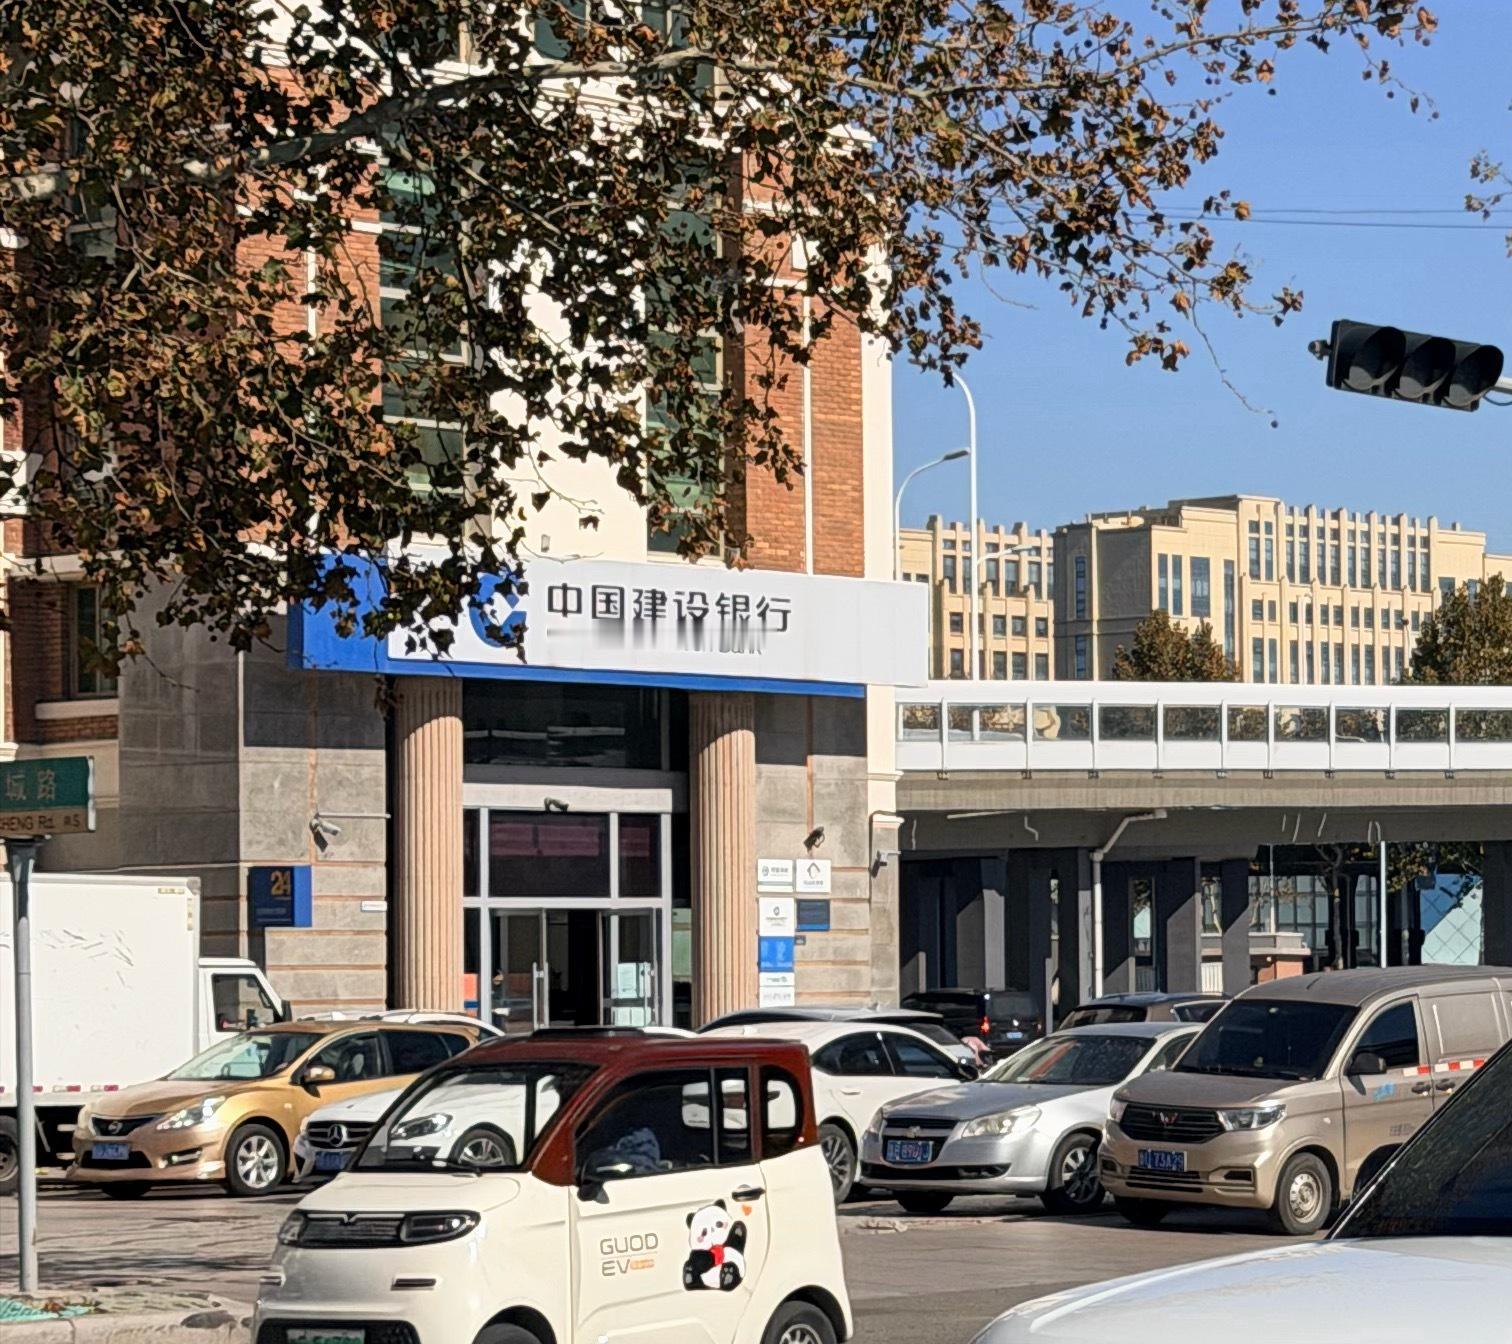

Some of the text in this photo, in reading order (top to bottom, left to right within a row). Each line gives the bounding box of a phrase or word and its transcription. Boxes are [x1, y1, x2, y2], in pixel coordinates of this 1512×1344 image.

[547, 582, 793, 632] 中国建设银行
[600, 1232, 659, 1255] GUOD
[602, 1258, 630, 1276] EV
